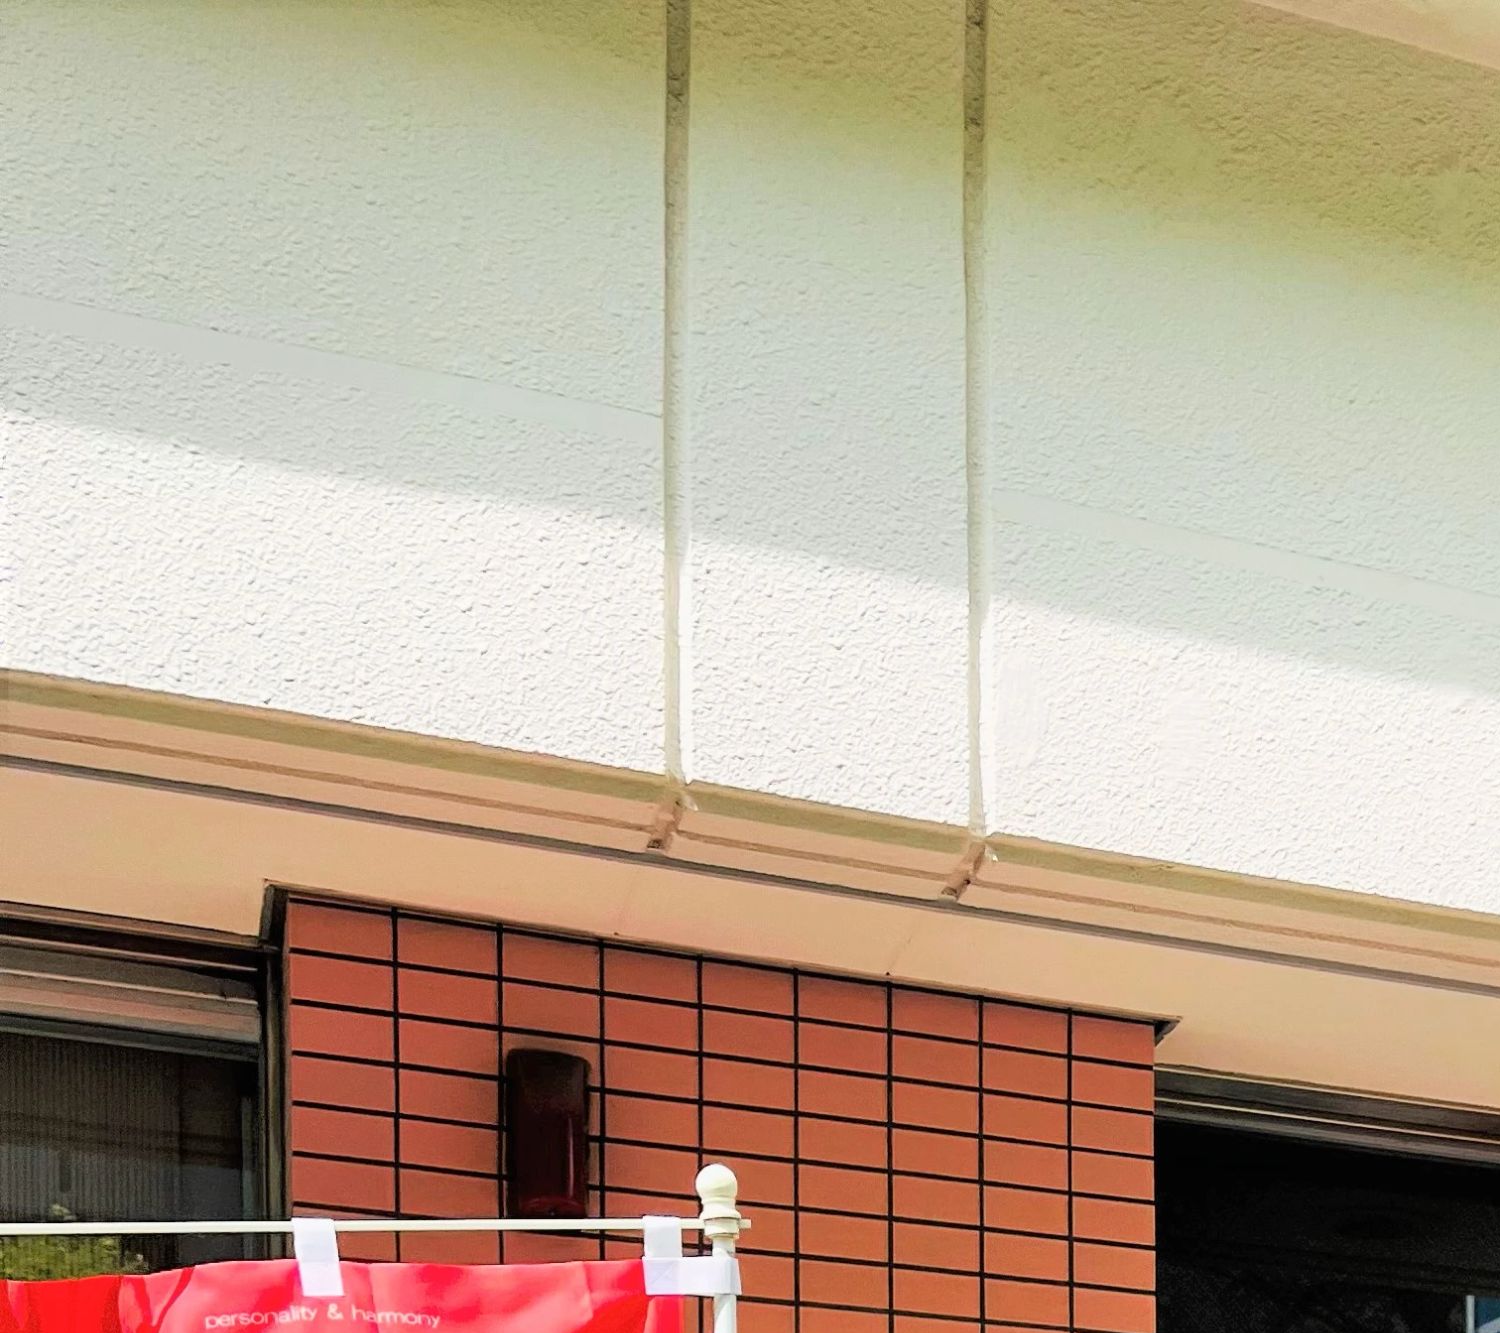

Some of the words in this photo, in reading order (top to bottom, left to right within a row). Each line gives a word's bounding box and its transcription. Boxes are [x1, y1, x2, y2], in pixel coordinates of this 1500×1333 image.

[204, 1304, 317, 1330] personality
[326, 1303, 344, 1321] &
[351, 1304, 440, 1329] harmony
